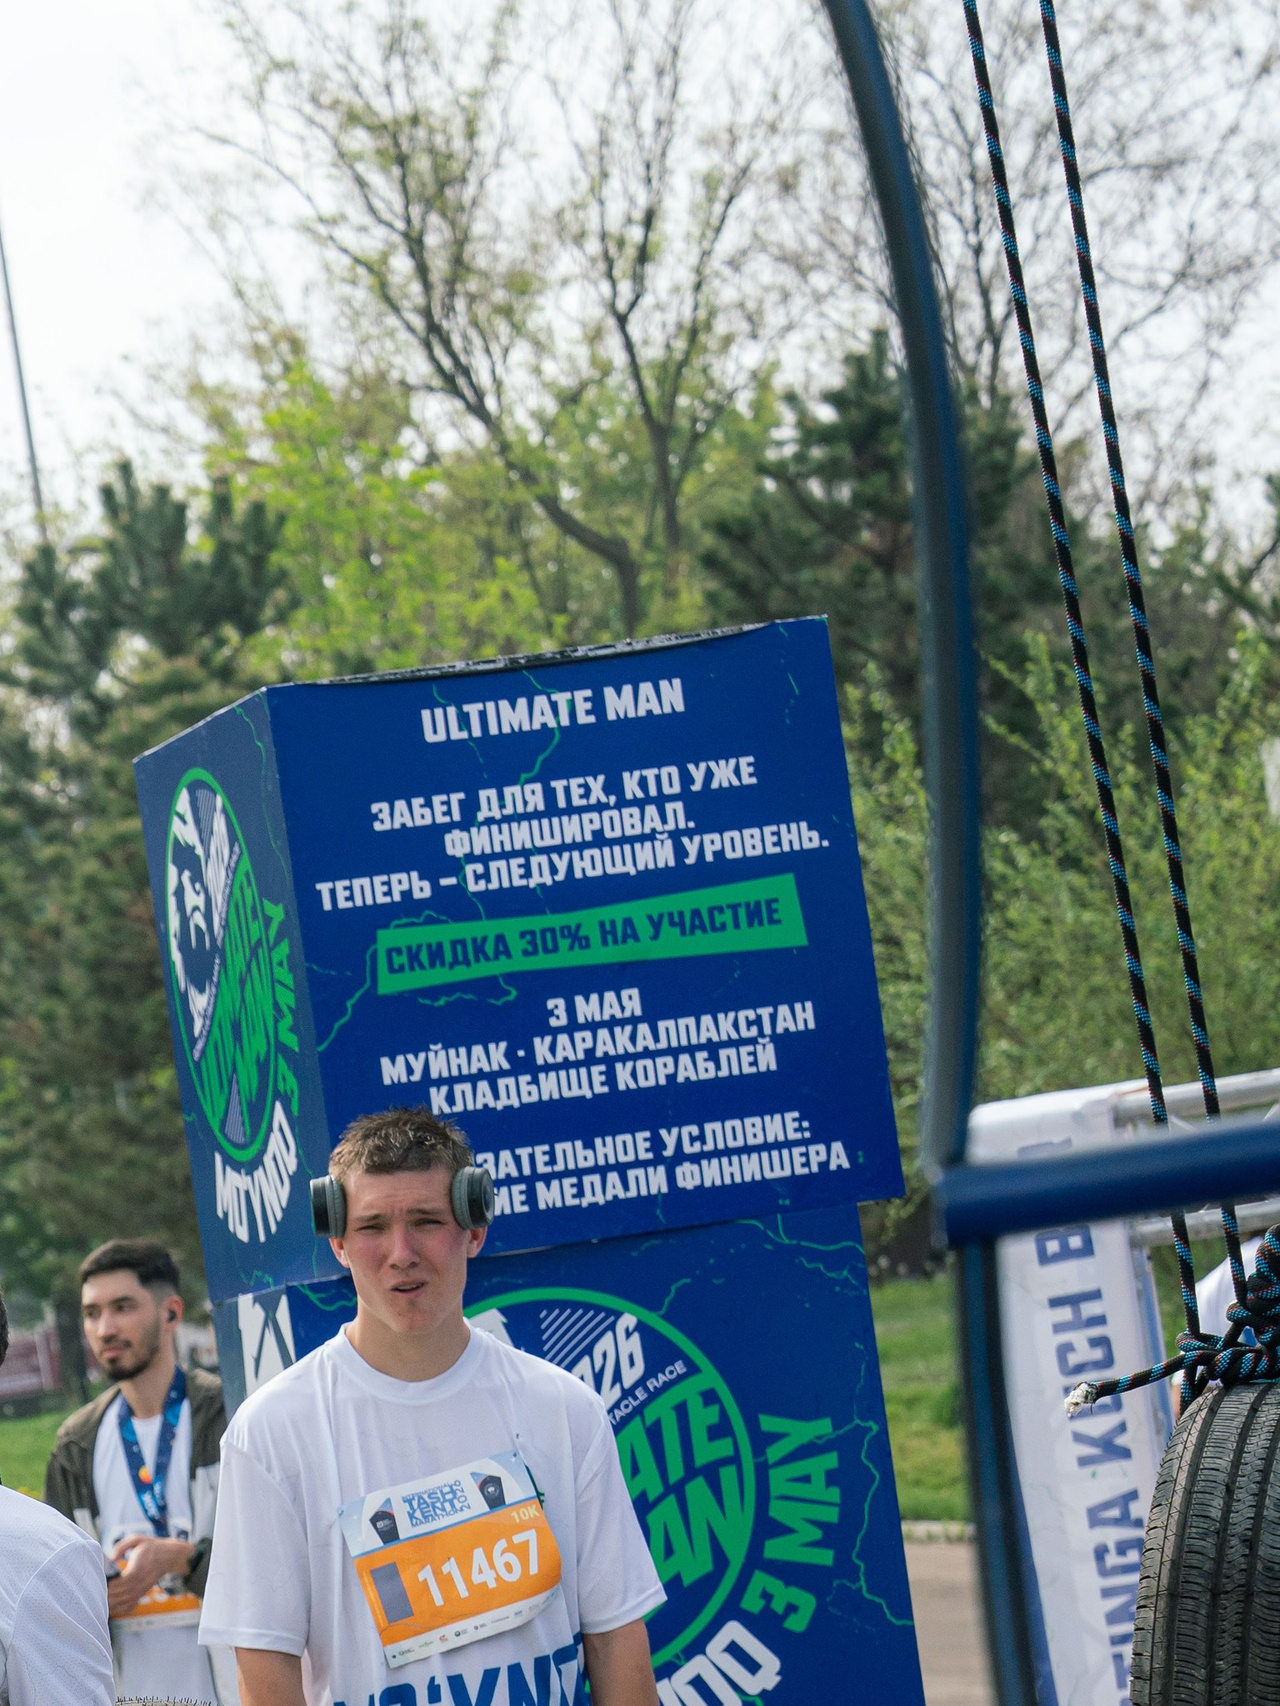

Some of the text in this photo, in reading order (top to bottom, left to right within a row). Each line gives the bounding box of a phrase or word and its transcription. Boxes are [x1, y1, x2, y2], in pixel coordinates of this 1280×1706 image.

[421, 678, 685, 743] ULTIMATE MAN
[371, 755, 757, 832] ЗАБЕГ ДЛЯ ТЕХ, КТО УЖЕ
[444, 801, 695, 858] ФИНИШИРОВАЛ.
[315, 870, 432, 911] ТЕПЕРЬ
[465, 832, 675, 892] СЛЕДУЮЩИЙ
[681, 821, 829, 865] УРОВЕНЬ.
[386, 898, 782, 974] СКИДКА 30% НА УЧАСТИЕ
[262, 898, 299, 1052] MAY
[547, 987, 642, 1027] 3 МАЯ
[380, 1042, 510, 1085] МУЙНАК
[533, 1001, 815, 1065] КАРАКАЛПАКСТАН
[429, 1036, 777, 1115] КЛАДБИЩЕ КОРАБЛЕЙ
[476, 1111, 811, 1180] ЗАТЕЛЬНОЕ УСЛОВИЕ:
[536, 1164, 668, 1210] МЕДАЛИ
[675, 1141, 850, 1190] ФИНИШЕРА
[646, 1360, 687, 1392] RACE
[402, 1484, 458, 1512] TASH
[407, 1499, 458, 1522] KENT
[511, 1504, 540, 1523] 10K
[647, 1466, 746, 1588] AN
[740, 1413, 841, 1633] 3 MAY
[417, 1528, 539, 1607] 11467
